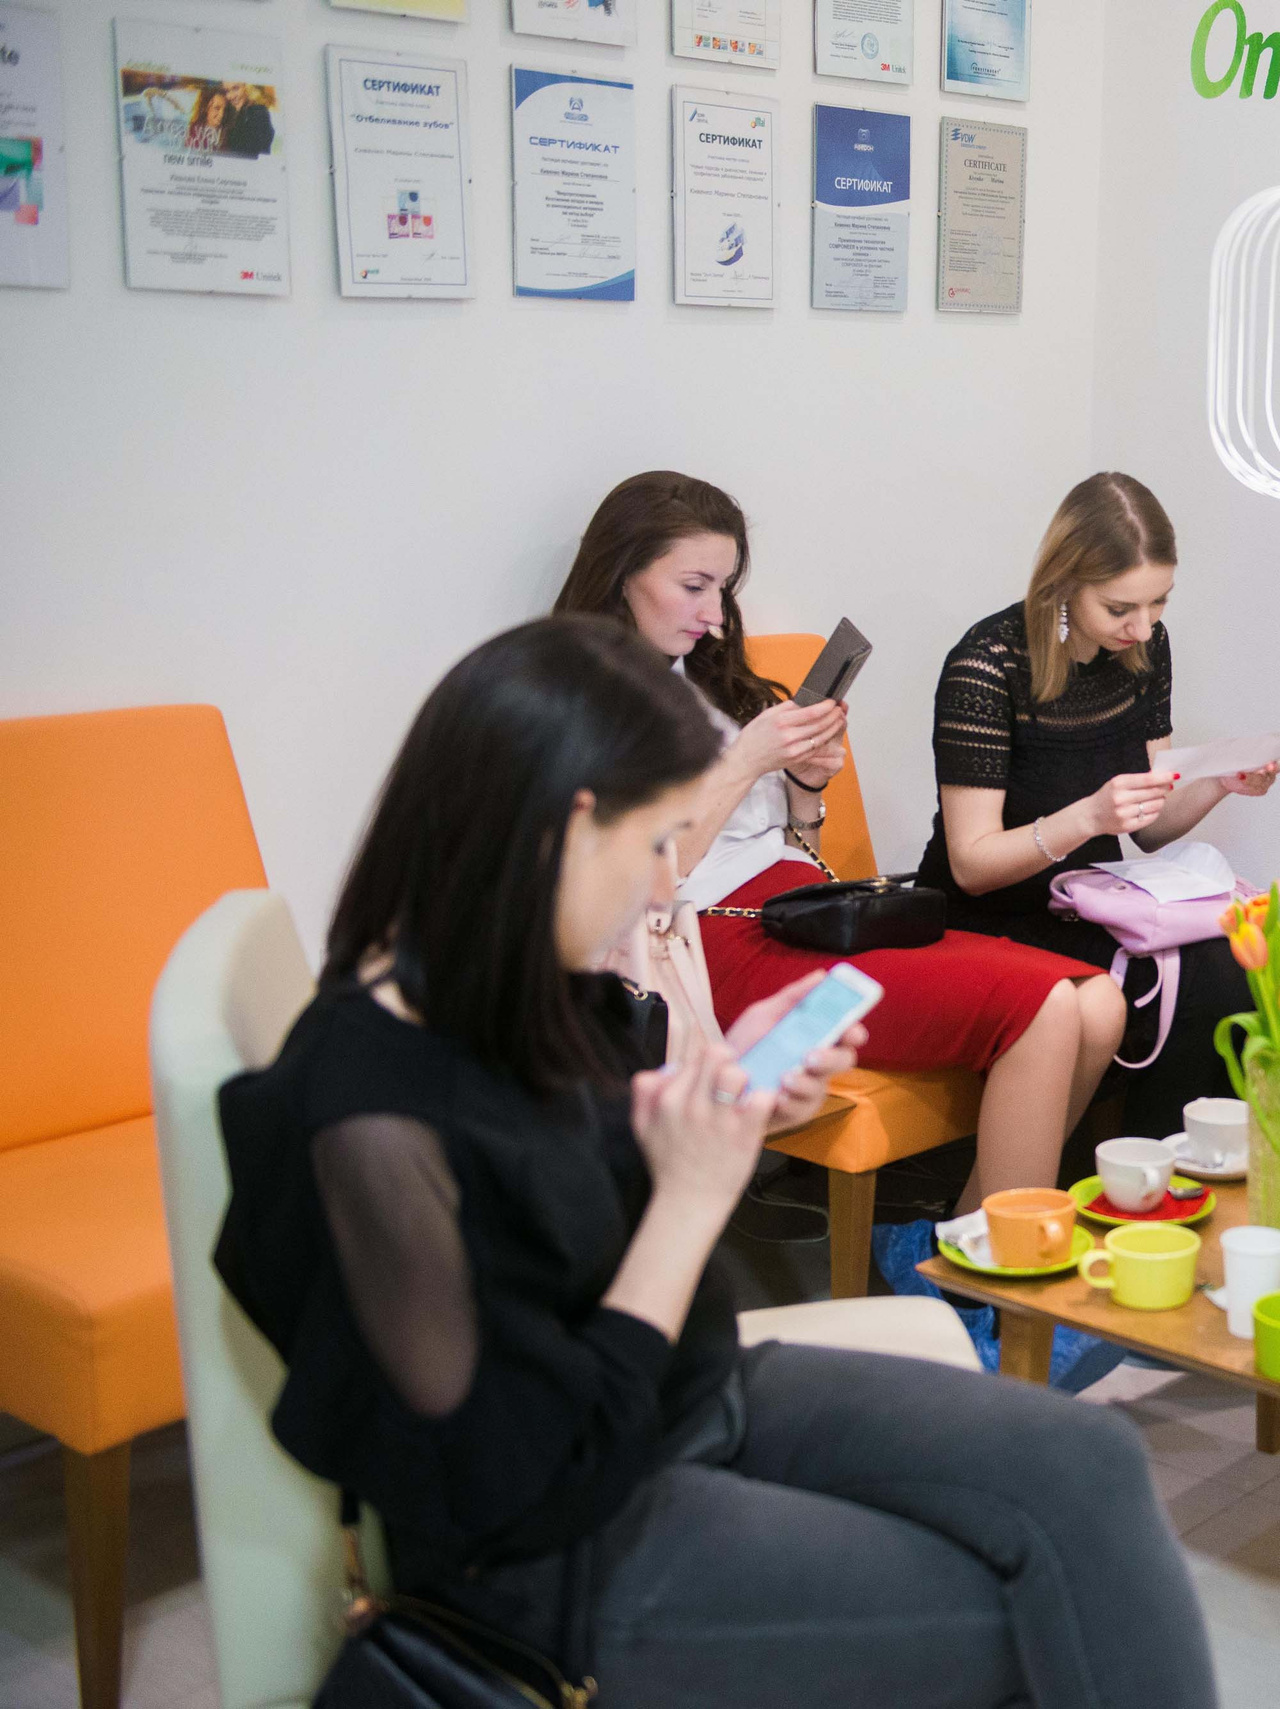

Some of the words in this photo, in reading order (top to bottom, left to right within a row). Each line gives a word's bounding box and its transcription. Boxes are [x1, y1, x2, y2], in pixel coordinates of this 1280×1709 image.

[881, 63, 891, 72] 3M
[363, 78, 441, 97] СЕРТИФИКАТ
[698, 132, 763, 150] СЕРТИФИКАТ
[960, 132, 977, 143] VDW
[529, 136, 620, 155] СЕРТИФИКАТ
[163, 153, 185, 166] new
[187, 154, 213, 168] smile
[963, 158, 1008, 173] CERTIFICATE
[834, 177, 893, 194] СЕРТИФИКАТ
[240, 270, 254, 281] 3M
